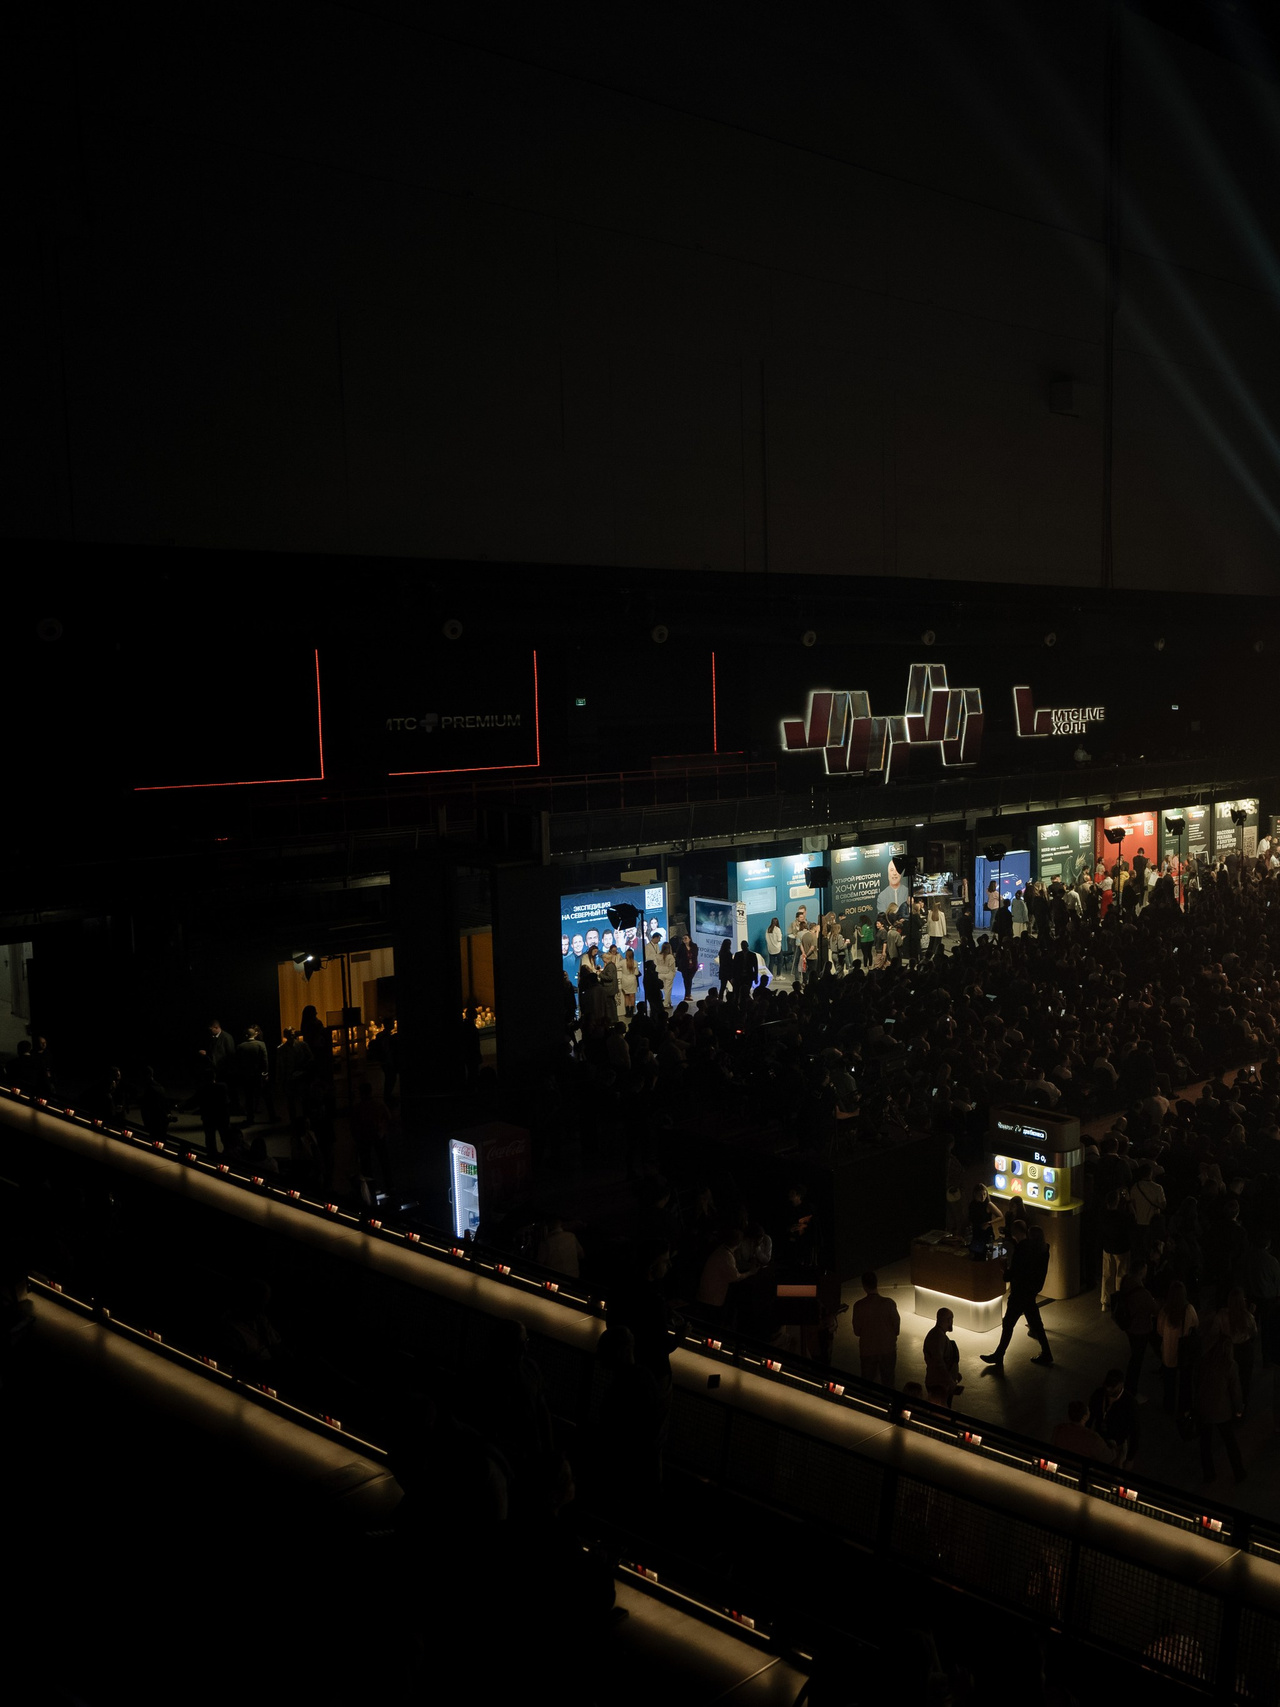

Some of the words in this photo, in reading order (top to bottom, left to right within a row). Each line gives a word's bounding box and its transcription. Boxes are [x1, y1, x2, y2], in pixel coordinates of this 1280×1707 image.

[441, 714, 521, 728] PREMIUM
[1080, 706, 1105, 722] LIVE
[1052, 720, 1086, 735] ХОЛЛ
[834, 875, 855, 884] ОТКРОЙ
[856, 872, 881, 882] РЕСТОРАН
[836, 883, 858, 894] ХОЧУ
[858, 880, 880, 890] ПУРИ
[571, 909, 600, 919] СЕВЕРНЫЙ
[573, 902, 611, 912] ЭКСПЕДИЦИЯ
